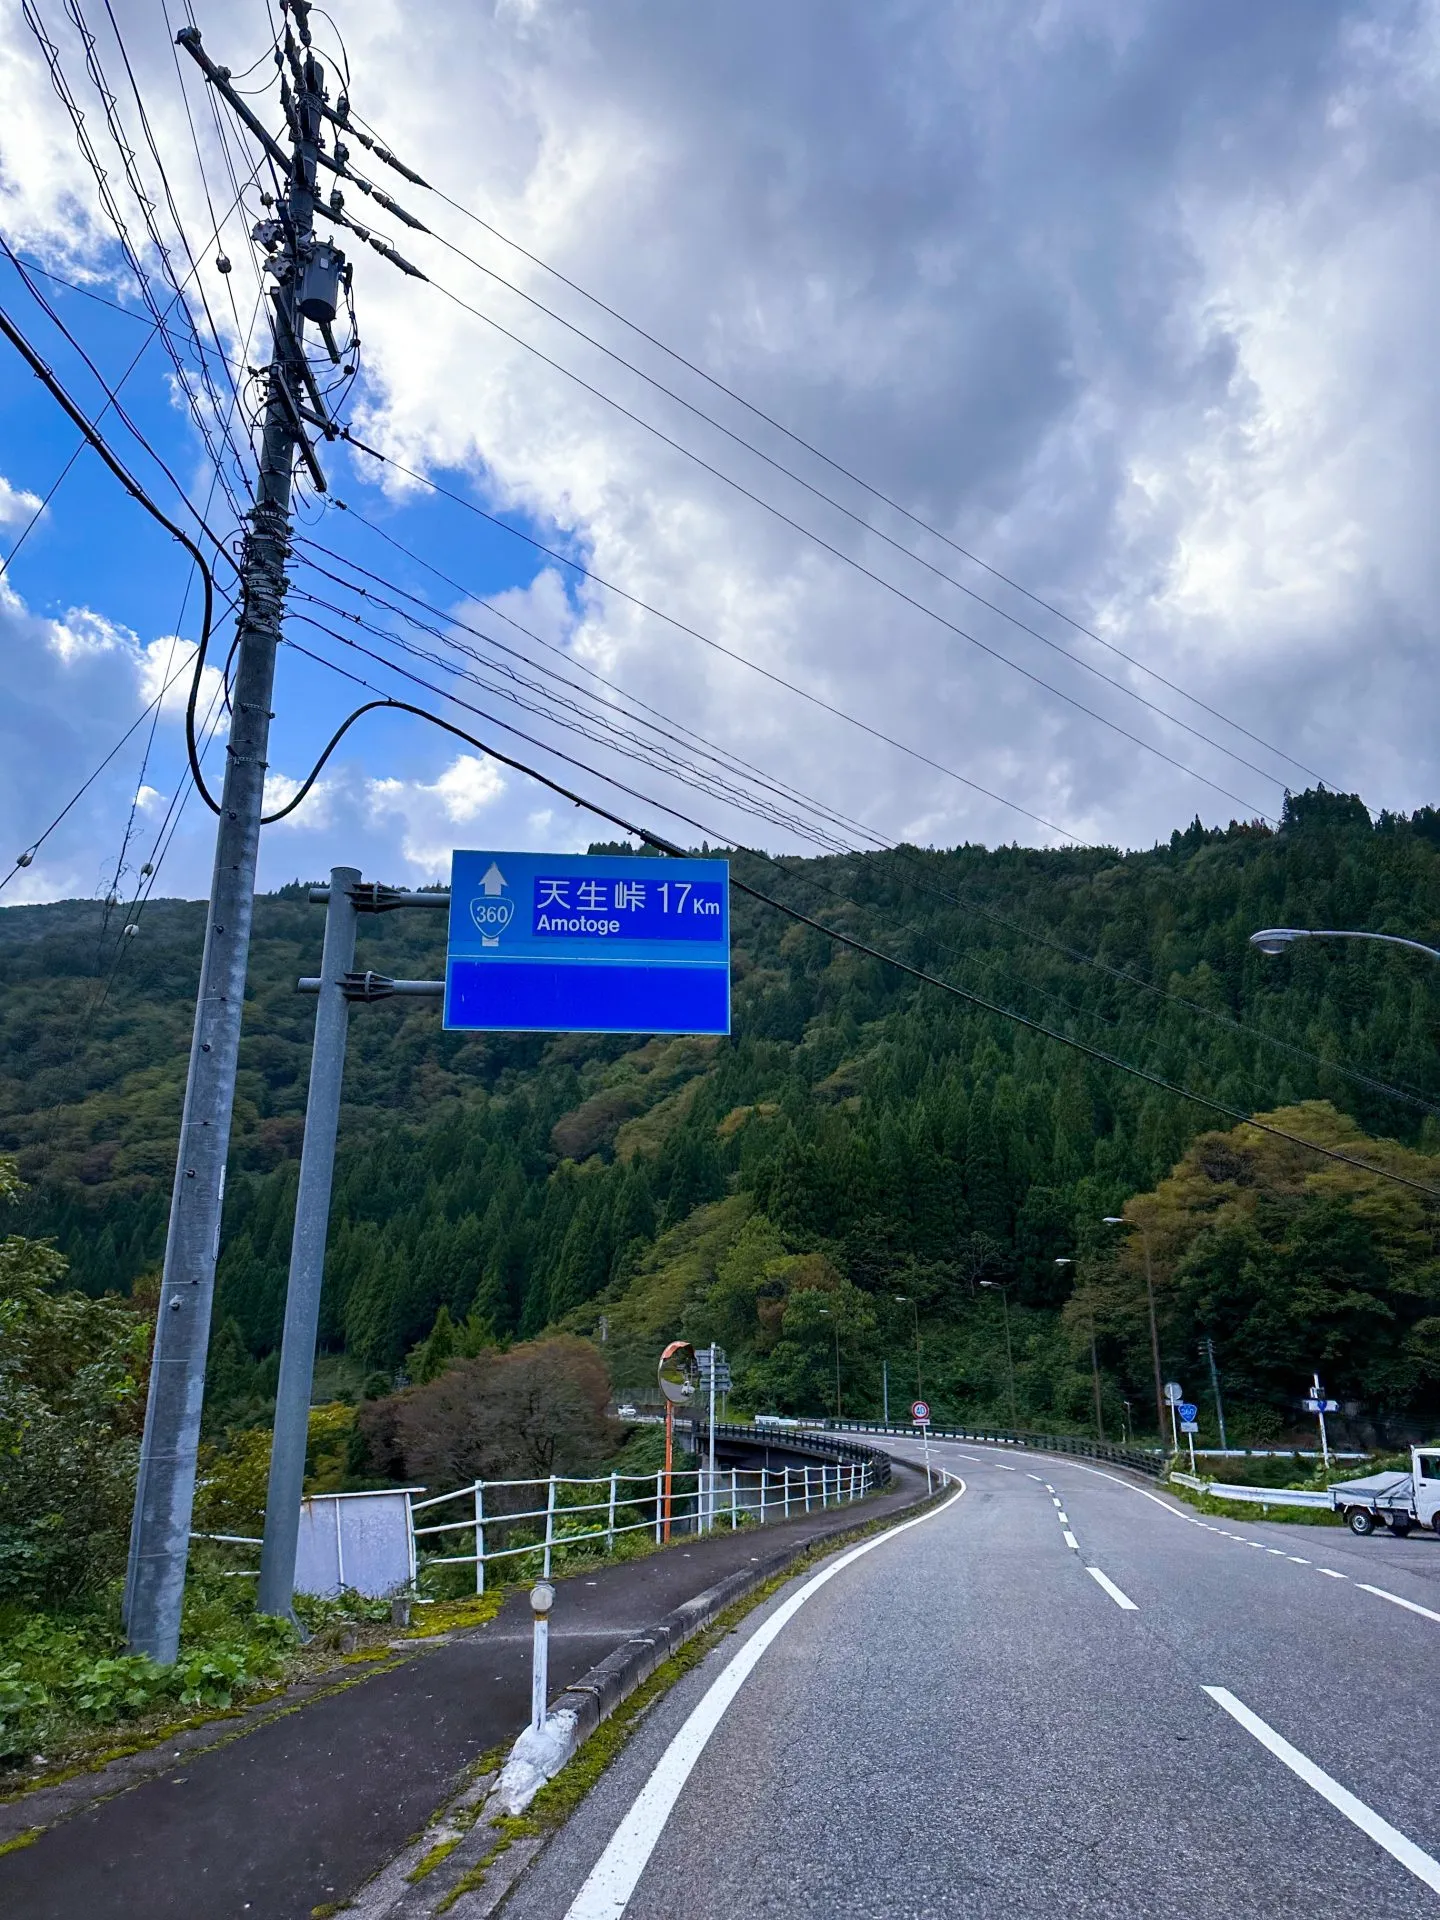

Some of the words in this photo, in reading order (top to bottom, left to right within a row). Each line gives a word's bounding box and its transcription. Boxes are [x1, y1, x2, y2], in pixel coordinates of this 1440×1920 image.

[537, 880, 646, 912] 天生峠
[657, 883, 692, 913] 17
[693, 898, 720, 915] Km
[476, 905, 508, 923] 360
[536, 914, 620, 935] Amotoge
